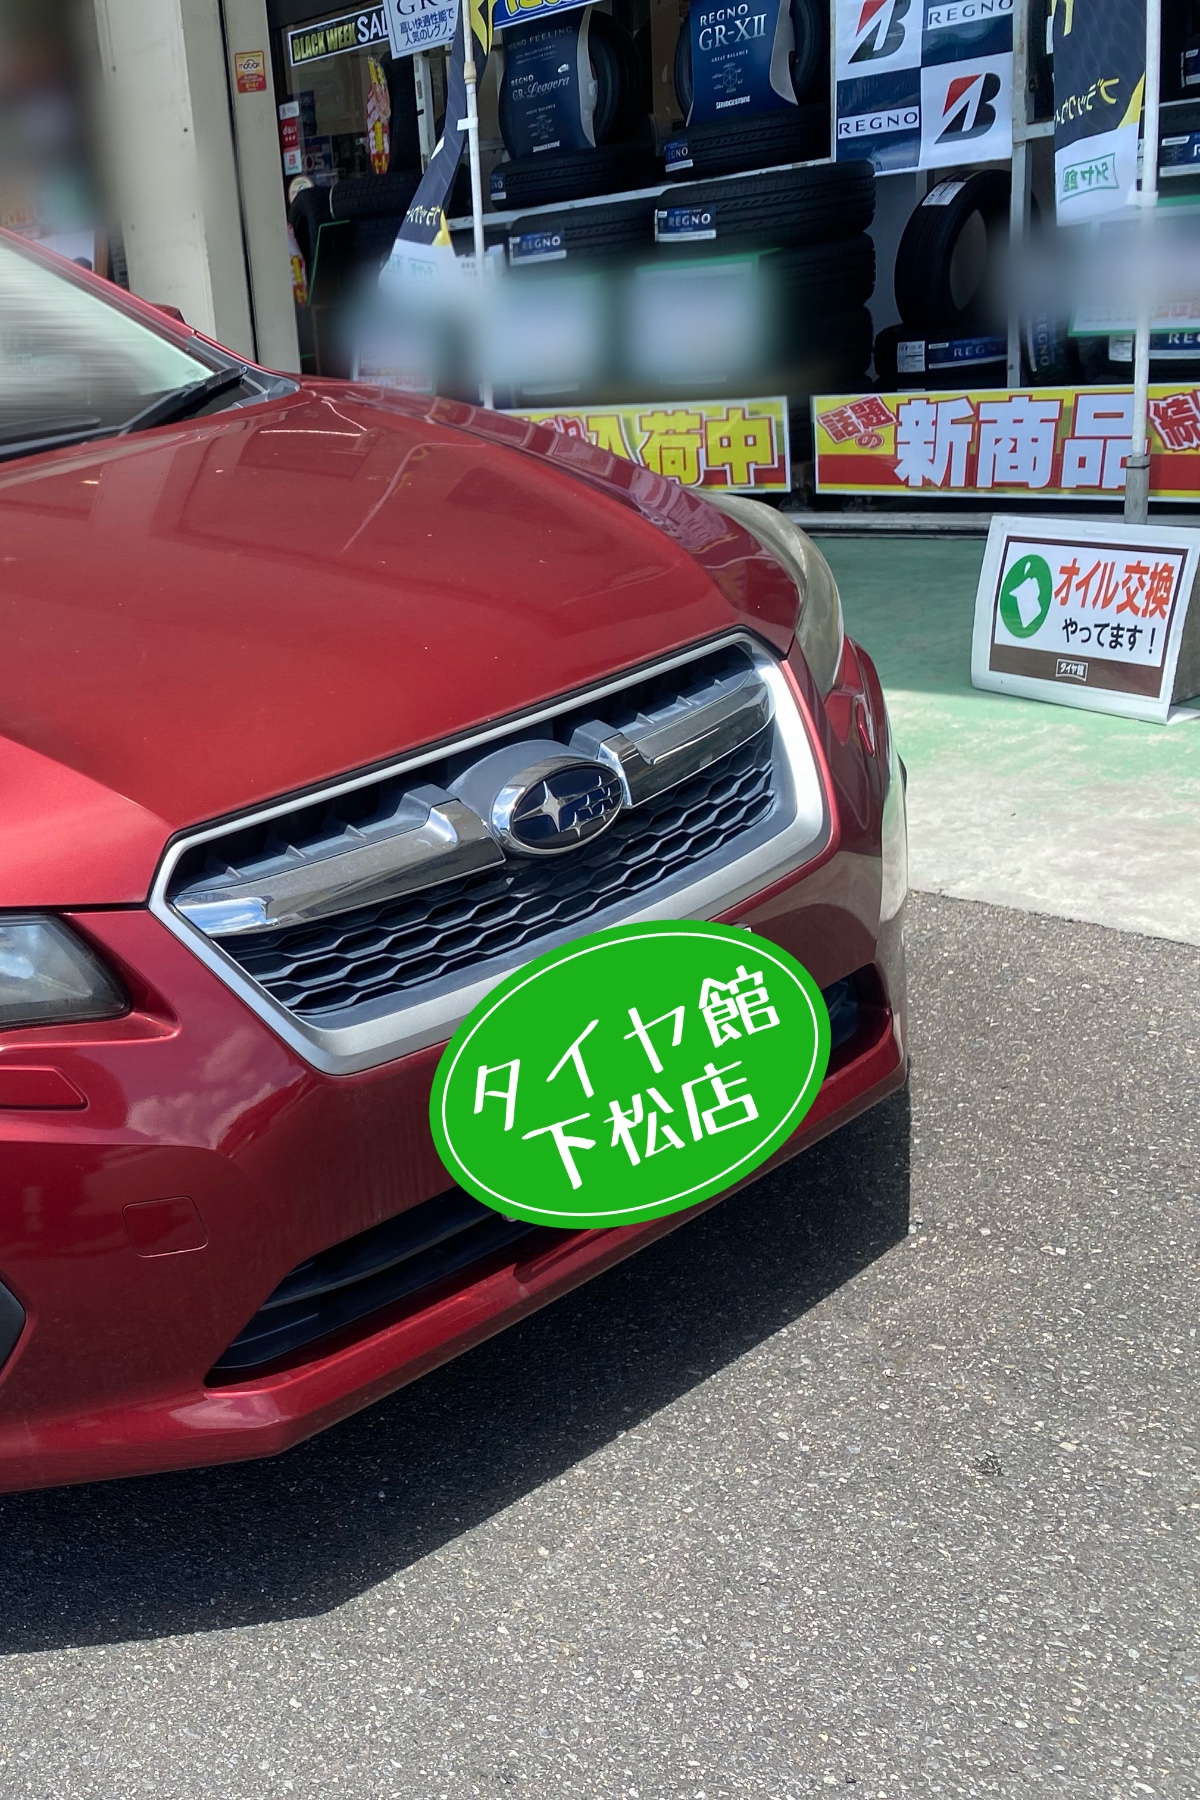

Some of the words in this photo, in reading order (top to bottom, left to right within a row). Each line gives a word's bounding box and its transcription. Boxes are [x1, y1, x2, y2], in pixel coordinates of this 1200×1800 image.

[397, 0, 452, 15] GR
[700, 4, 749, 27] REGNO
[929, 0, 1014, 25] REGNO
[399, 8, 455, 34] 高い快適性能で
[293, 32, 327, 61] BLACK
[325, 21, 358, 53] WEEK
[356, 9, 388, 43] SAL
[511, 74, 534, 87] REGNO
[512, 76, 570, 101] GR-Leggera
[839, 112, 918, 135] REGNO
[669, 213, 711, 228] REGNO
[521, 235, 561, 251] REGNO
[1168, 332, 1200, 345] RE
[895, 396, 1147, 490] 新商品
[1054, 557, 1175, 620] オイル交換
[1059, 662, 1085, 677] タイヤ館
